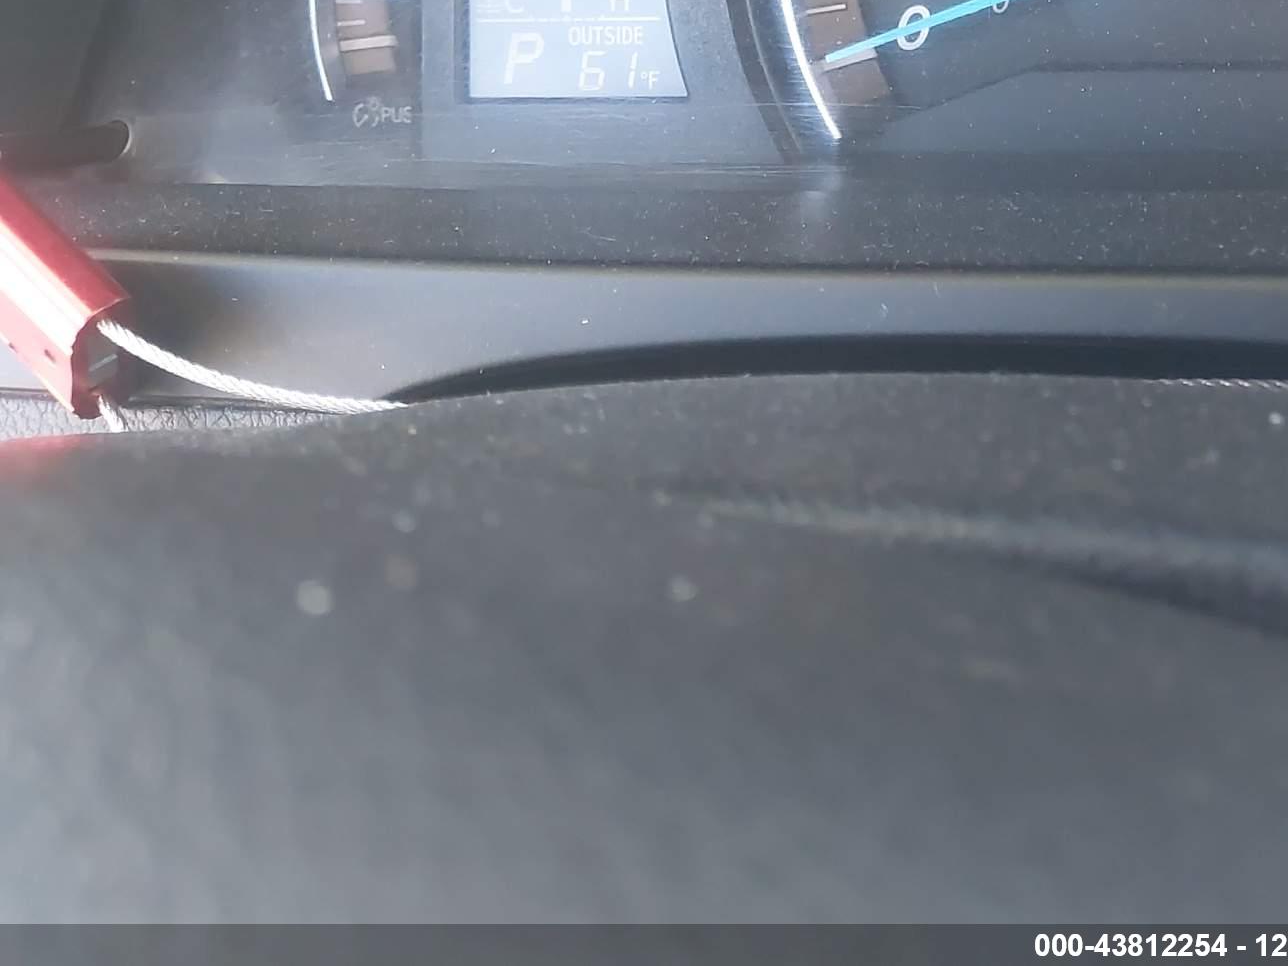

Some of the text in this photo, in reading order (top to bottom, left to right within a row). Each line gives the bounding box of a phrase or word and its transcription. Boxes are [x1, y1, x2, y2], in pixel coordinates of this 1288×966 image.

[568, 26, 643, 46] OUTSIDE
[896, 5, 931, 51] 0
[504, 32, 544, 85] P
